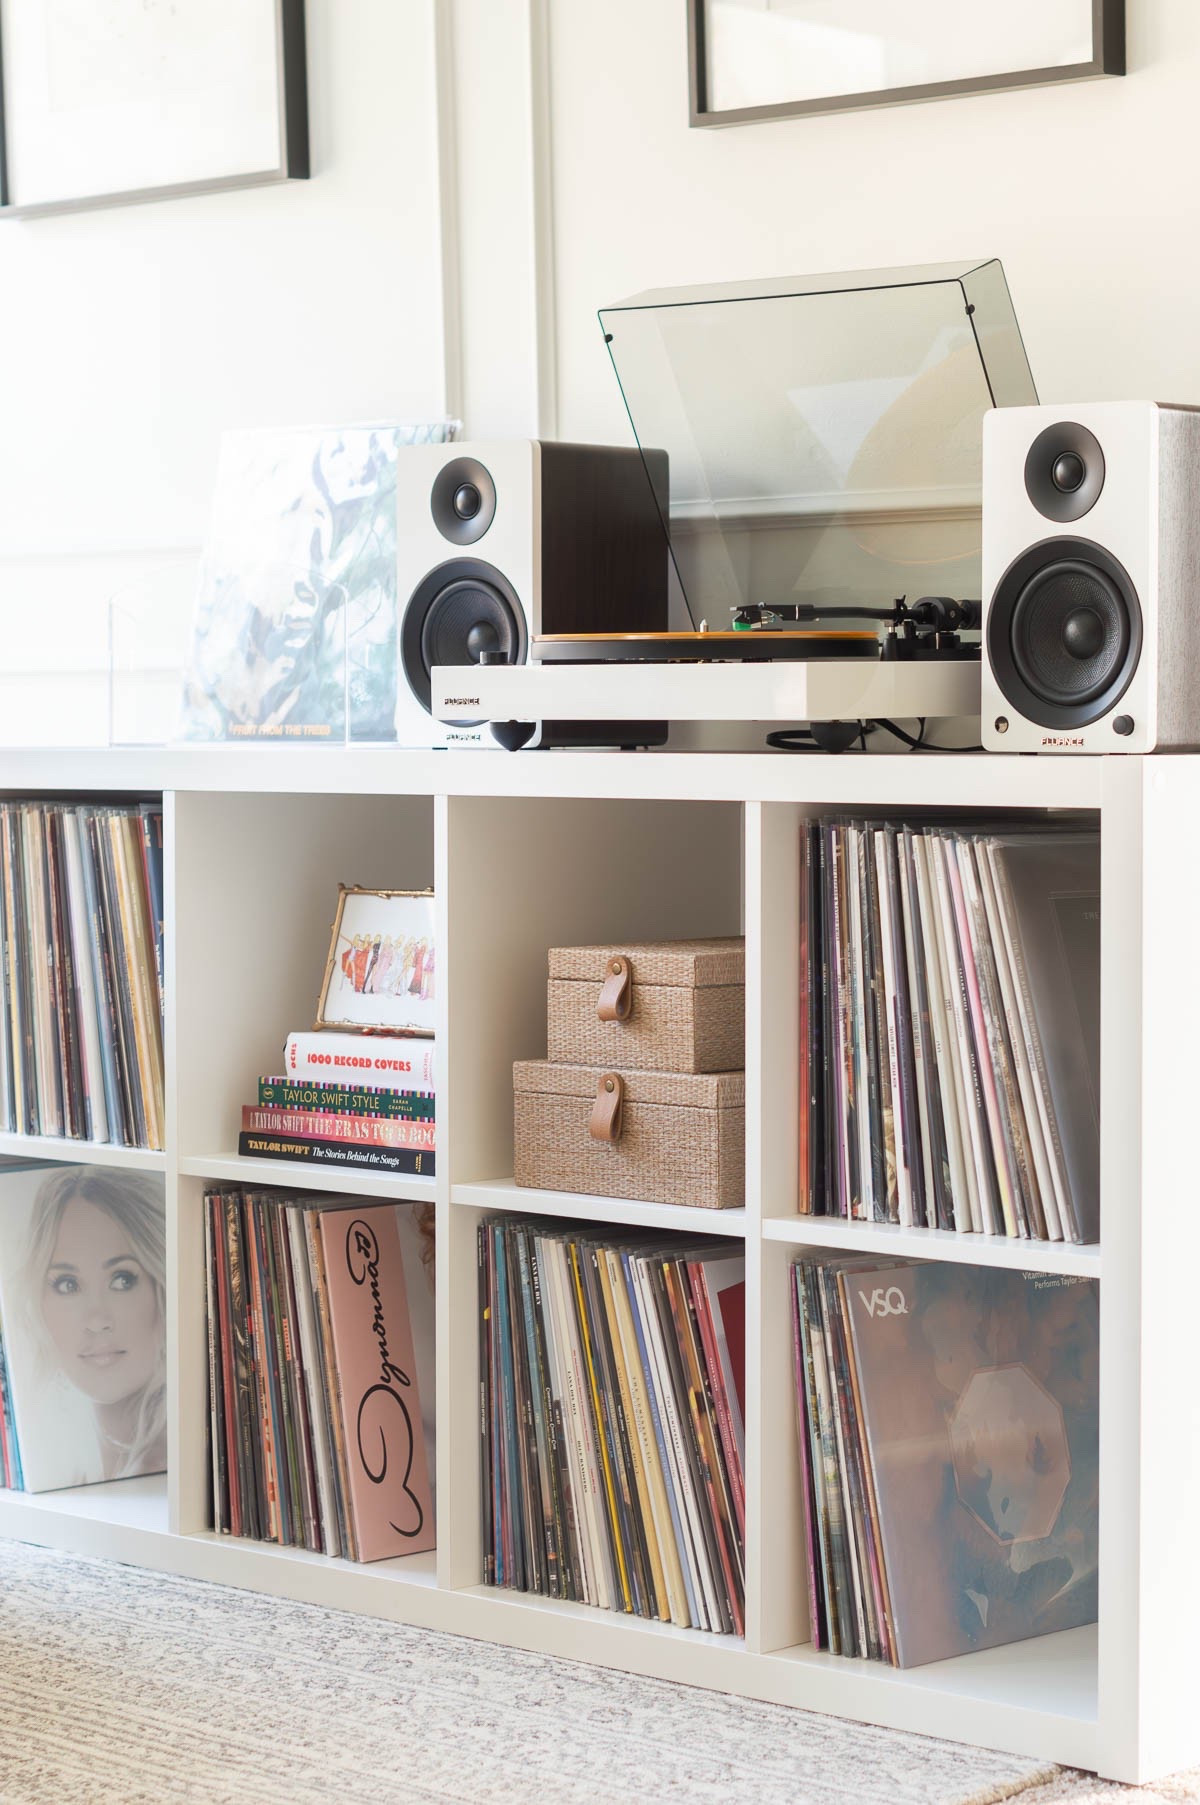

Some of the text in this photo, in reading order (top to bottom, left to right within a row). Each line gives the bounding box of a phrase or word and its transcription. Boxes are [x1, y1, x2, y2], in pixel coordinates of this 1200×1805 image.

[1041, 738, 1084, 746] FLUANCE
[1015, 956, 1028, 995] TORTURED
[1023, 997, 1033, 1020] POETS
[1029, 1023, 1044, 1071] DEPARTMENT
[307, 1053, 412, 1072] 1000 RECORD COVERS
[283, 1088, 379, 1109] TAYLOR SWIFT STYLE
[255, 1112, 282, 1130] TAYLOR
[283, 1115, 304, 1132] SWIFT
[305, 1116, 332, 1135] THE
[336, 1120, 369, 1138] ERAS
[371, 1123, 406, 1142] TOUR
[248, 1140, 400, 1167] TAYLOR SWIFT The Stories Behind the Songs
[1034, 1280, 1060, 1289] Performs
[1061, 1278, 1077, 1287] Taylor
[858, 1286, 909, 1318] VSQ
